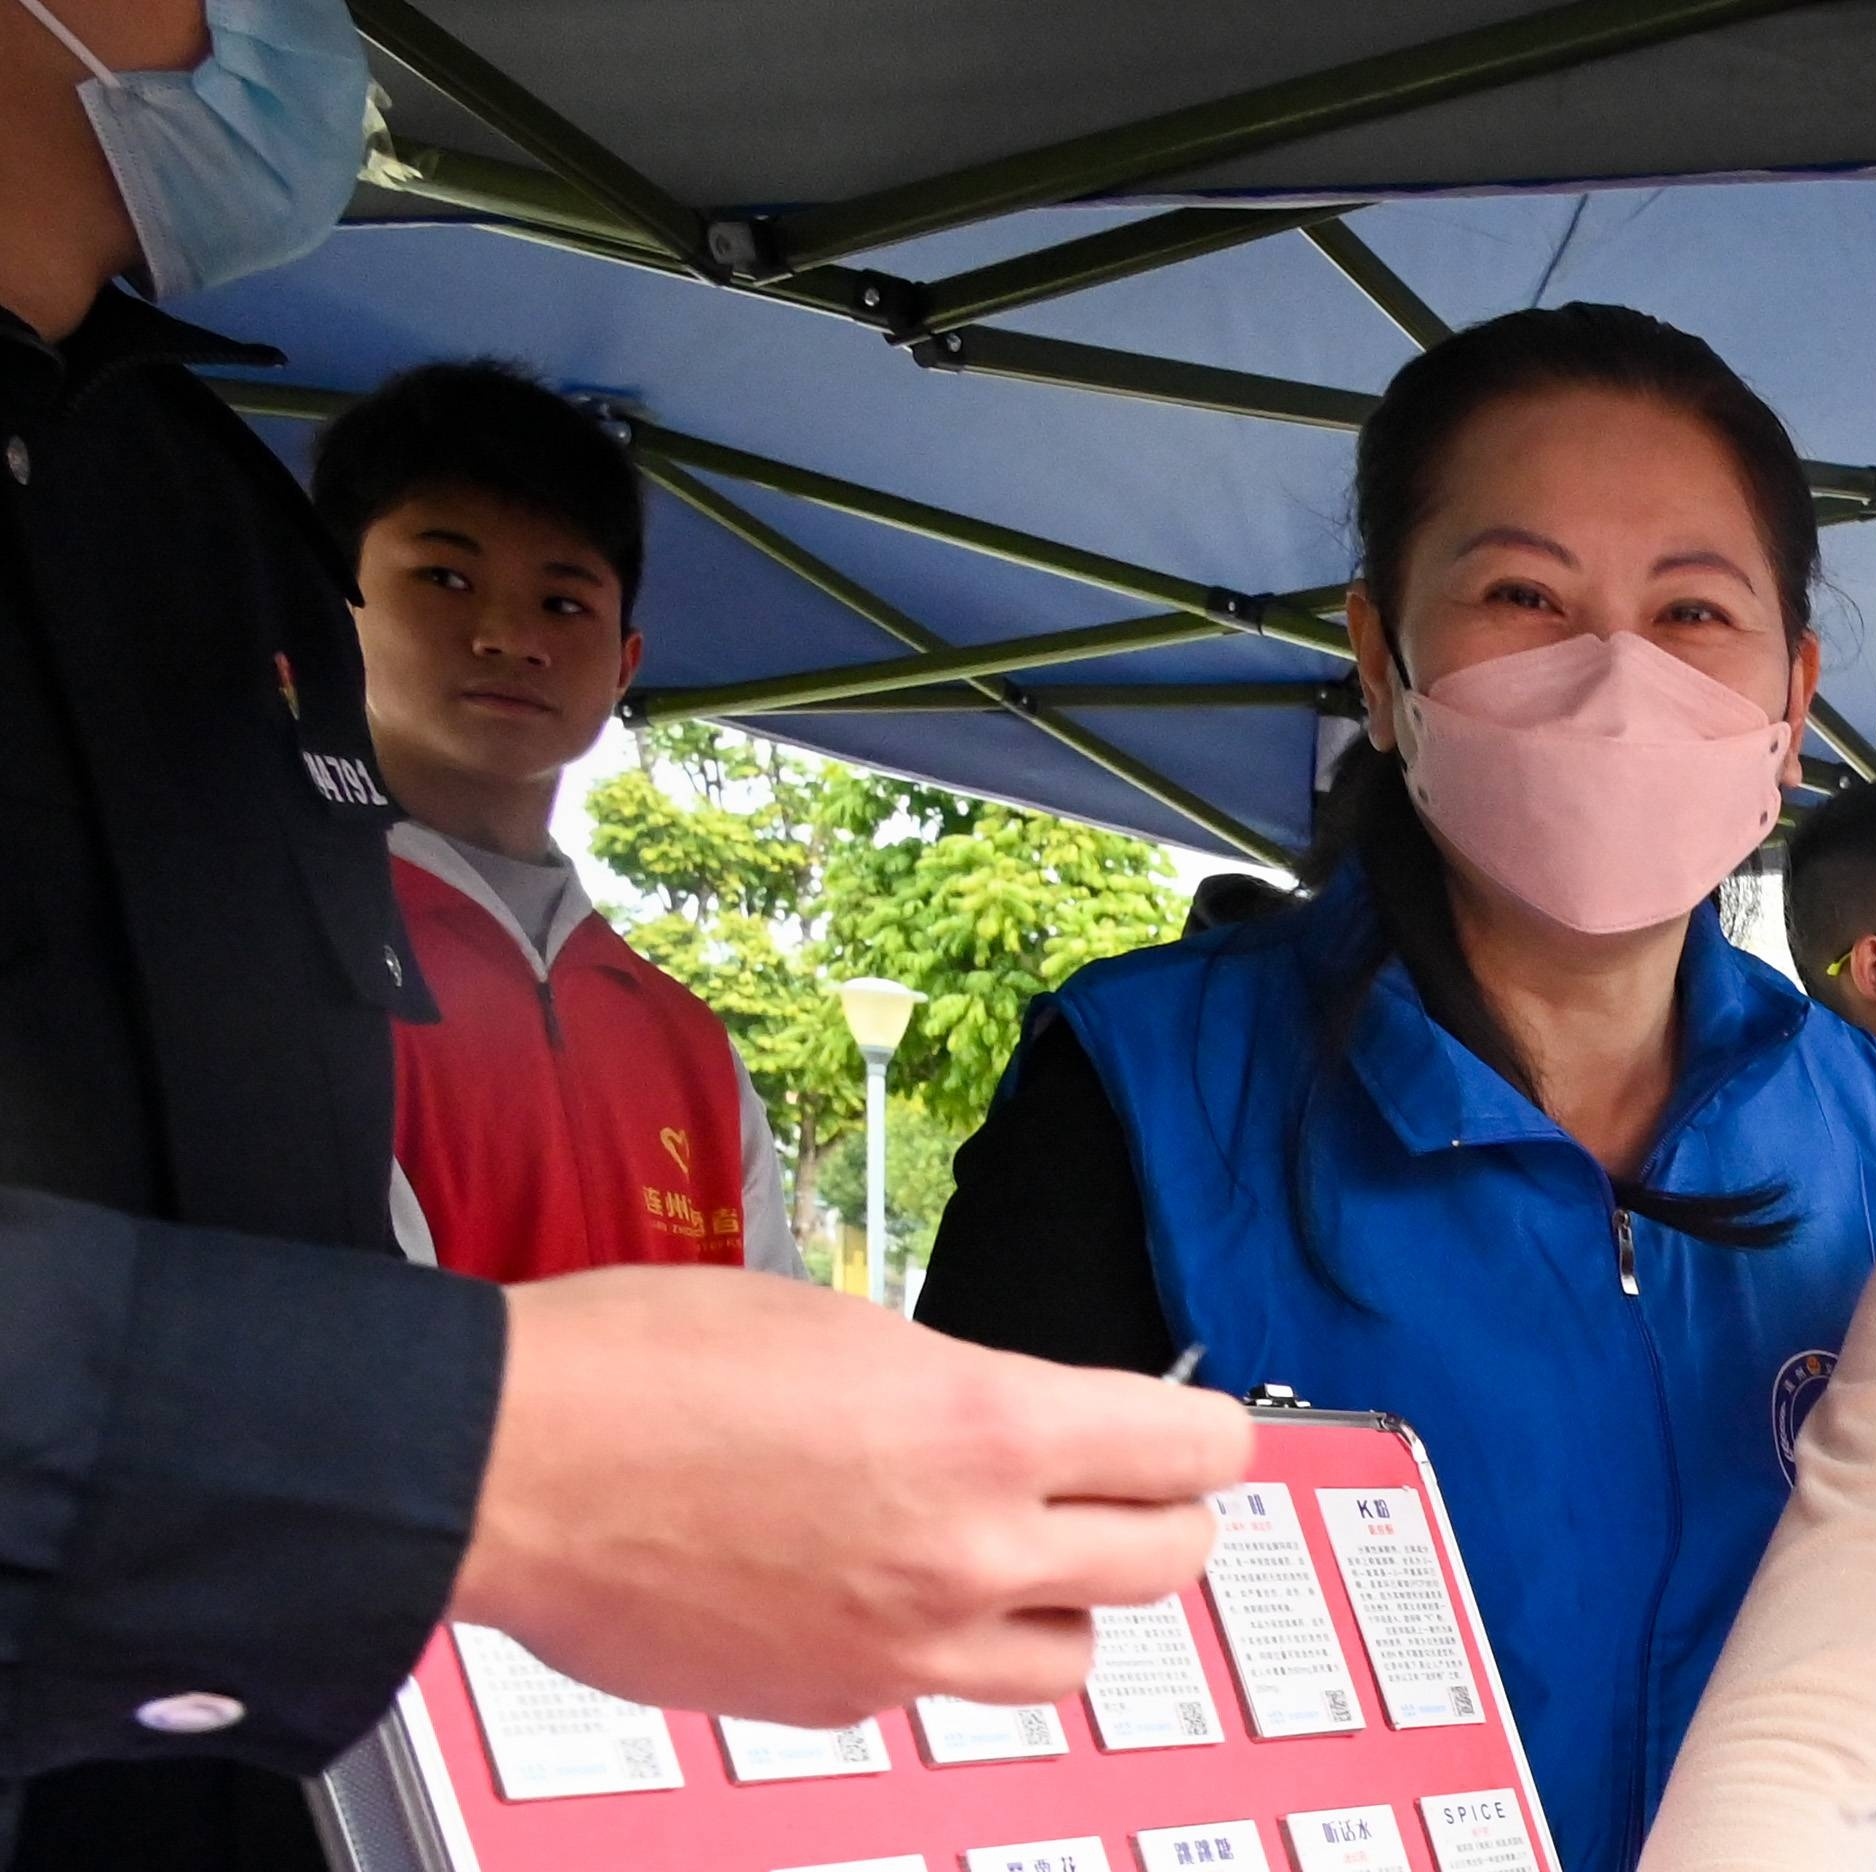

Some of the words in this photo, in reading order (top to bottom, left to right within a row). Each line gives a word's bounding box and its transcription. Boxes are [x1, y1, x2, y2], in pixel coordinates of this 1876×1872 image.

[1443, 1801, 1508, 1825] SPICE
[1323, 1818, 1374, 1846] 听话水
